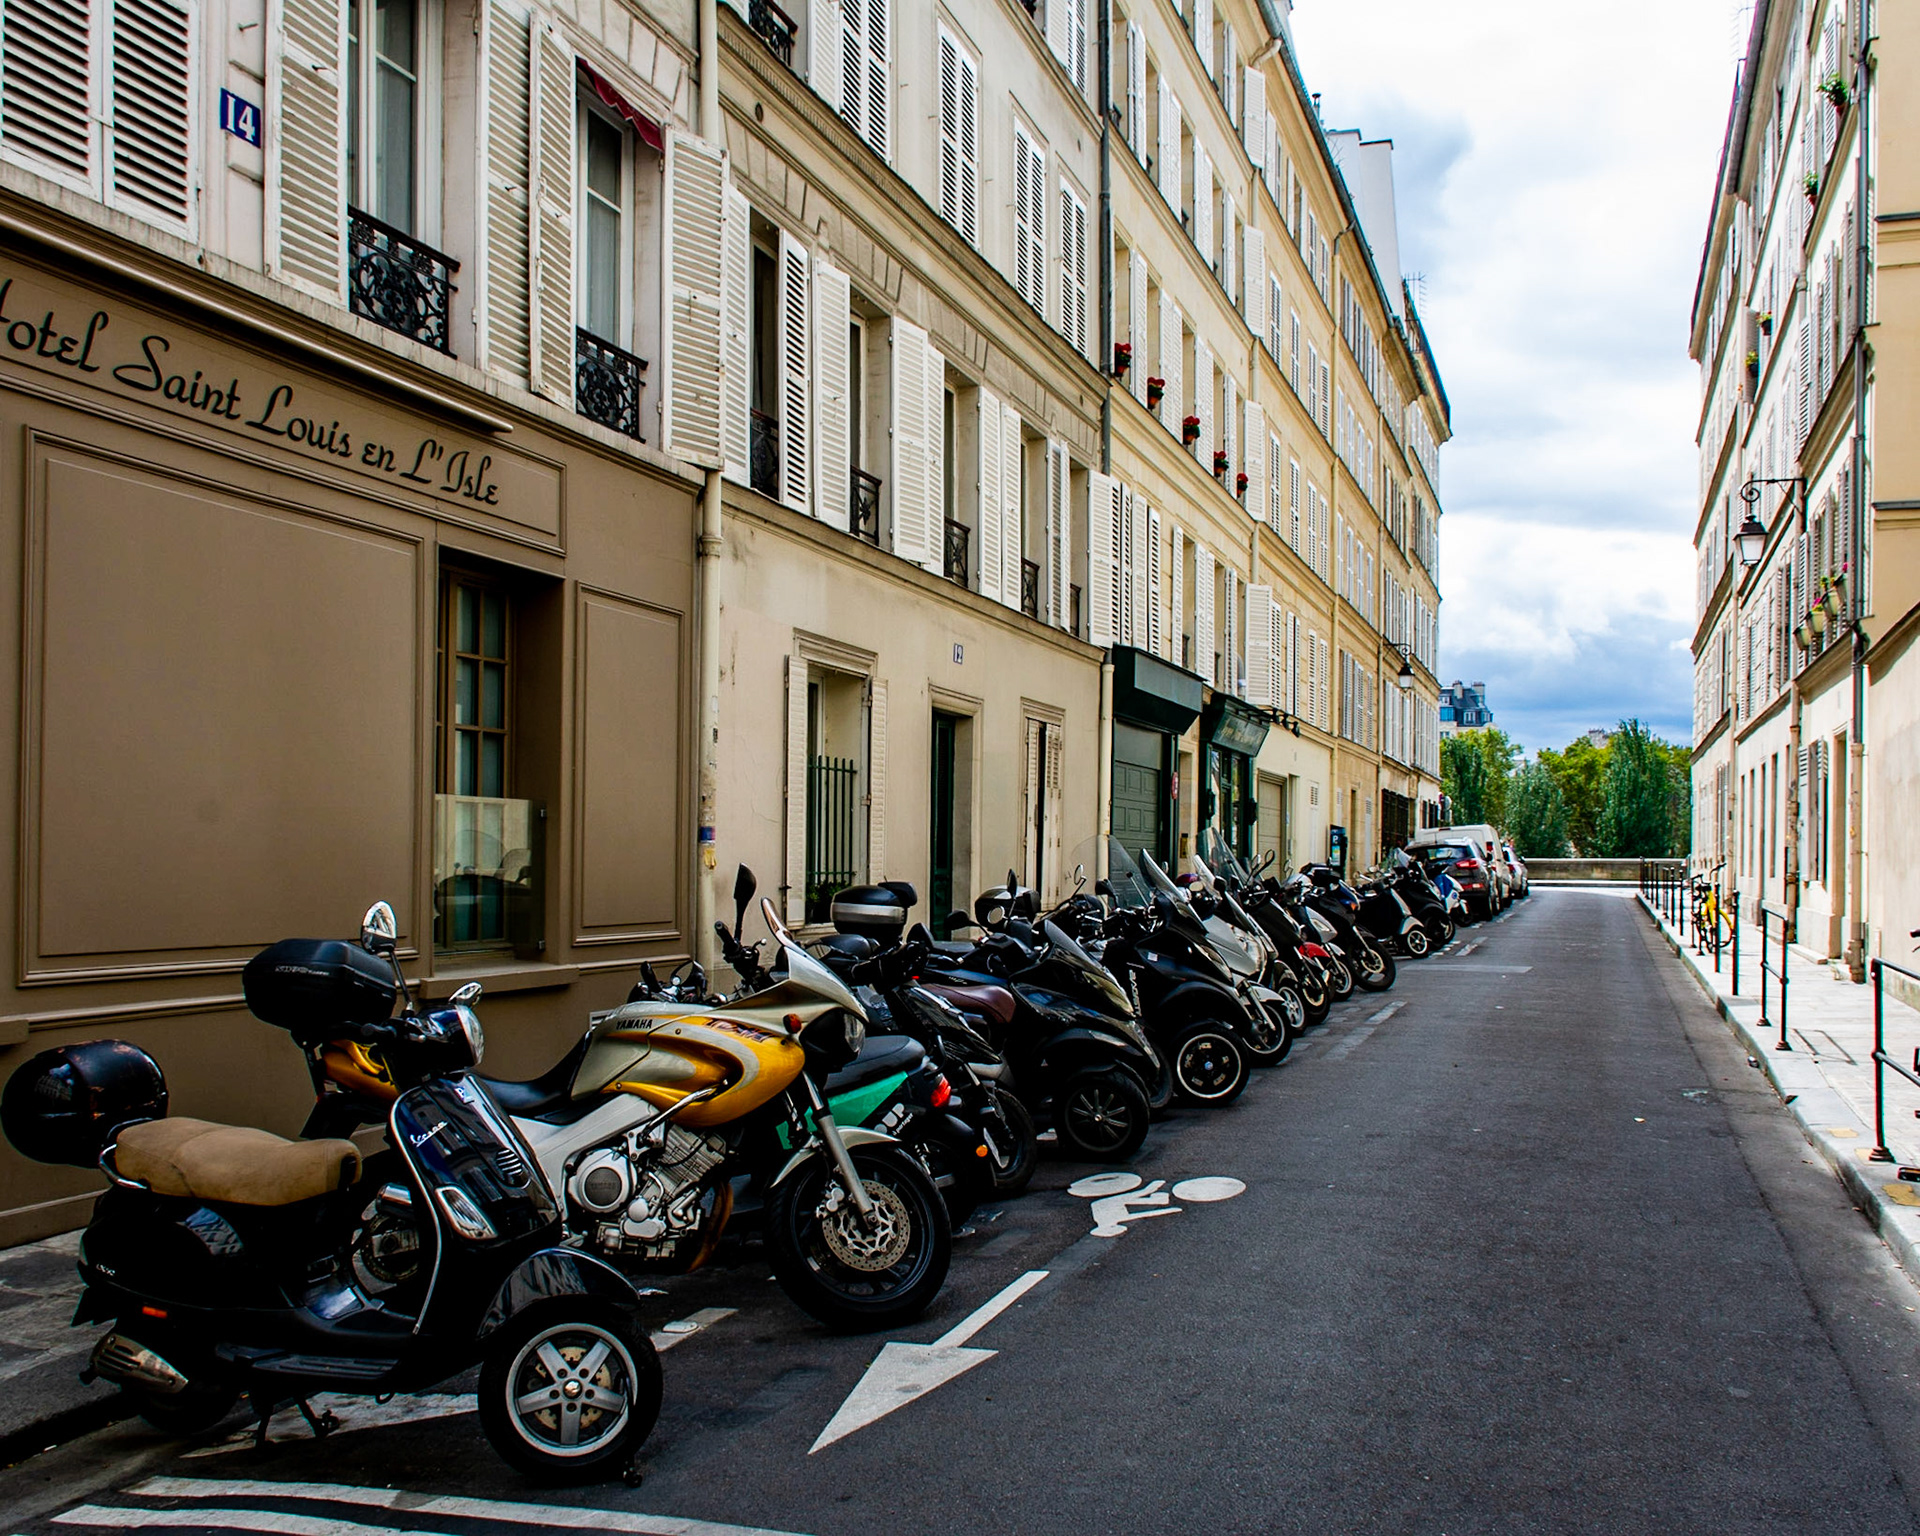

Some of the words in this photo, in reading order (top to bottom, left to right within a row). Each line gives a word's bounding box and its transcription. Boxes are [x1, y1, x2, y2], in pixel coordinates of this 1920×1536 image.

[226, 94, 255, 142] 14
[112, 335, 241, 420] Saint
[245, 385, 352, 458] Louis
[361, 443, 396, 472] en
[400, 439, 499, 505] L'Isle
[954, 644, 963, 663] 12
[616, 1019, 653, 1030] YAMAHA
